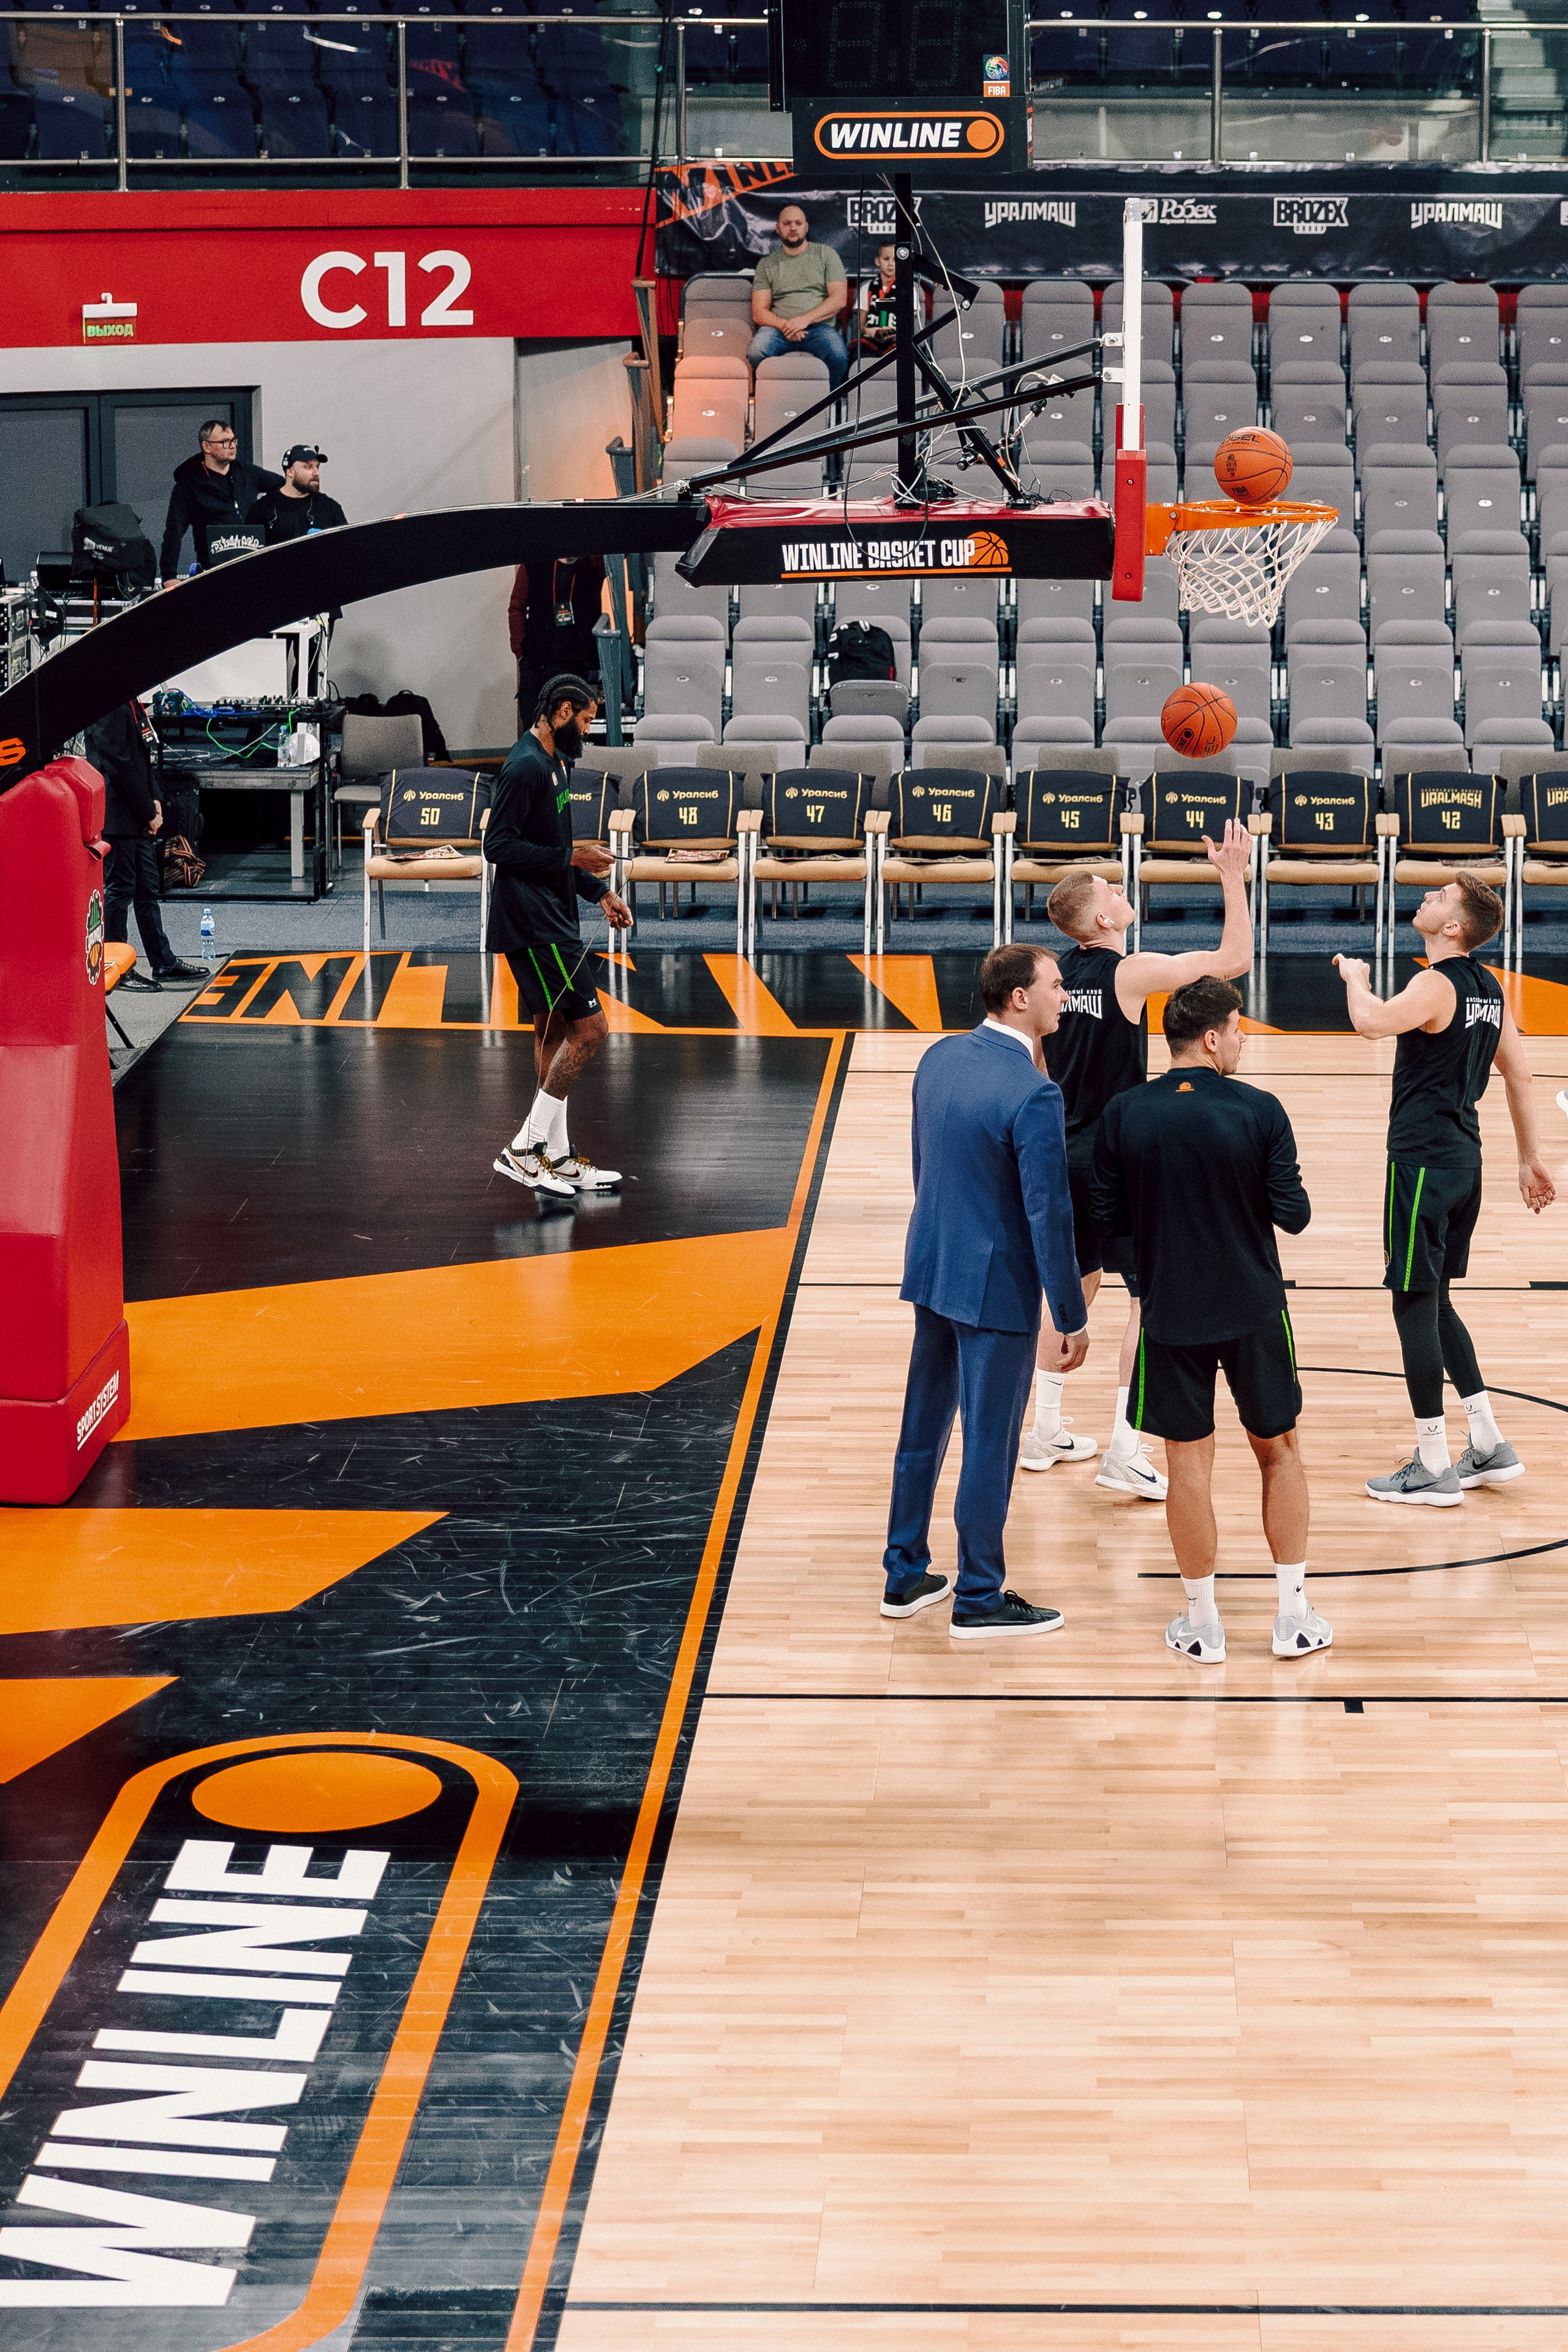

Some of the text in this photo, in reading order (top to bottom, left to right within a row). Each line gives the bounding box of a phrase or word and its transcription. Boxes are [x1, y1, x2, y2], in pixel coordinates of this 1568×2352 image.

[988, 86, 1006, 96] FIBA
[831, 123, 962, 148] WINLINE
[984, 202, 1076, 228] УРАЛМАШ
[1161, 198, 1217, 219] Робек
[1276, 198, 1348, 225] BROZEX
[1411, 202, 1503, 230] УРАЛМАШ
[300, 250, 475, 329] C12
[87, 324, 134, 337] ВЫХОД
[782, 539, 975, 571] WINLINE BASKET CUP
[420, 791, 464, 801] Уралсиб
[569, 792, 592, 801] лсиб
[673, 791, 719, 800] Уралсиб
[801, 788, 848, 799] Уралсиб
[929, 787, 975, 798] Уралсиб
[1058, 794, 1103, 804] Уралсиб
[1181, 794, 1227, 804] Уралсиб
[1310, 796, 1355, 806] Уралсиб
[1421, 791, 1482, 809] URALMASH
[420, 807, 440, 825] 50
[679, 807, 698, 825] 48
[806, 805, 825, 823] 47
[932, 804, 952, 822] 46
[1061, 810, 1080, 828] 45
[1186, 810, 1204, 829] 44
[1315, 812, 1334, 831] 43
[1442, 811, 1461, 829] 42
[77, 1370, 119, 1443] SPORTSYSTEM
[0, 1839, 390, 2307] WINLINE
